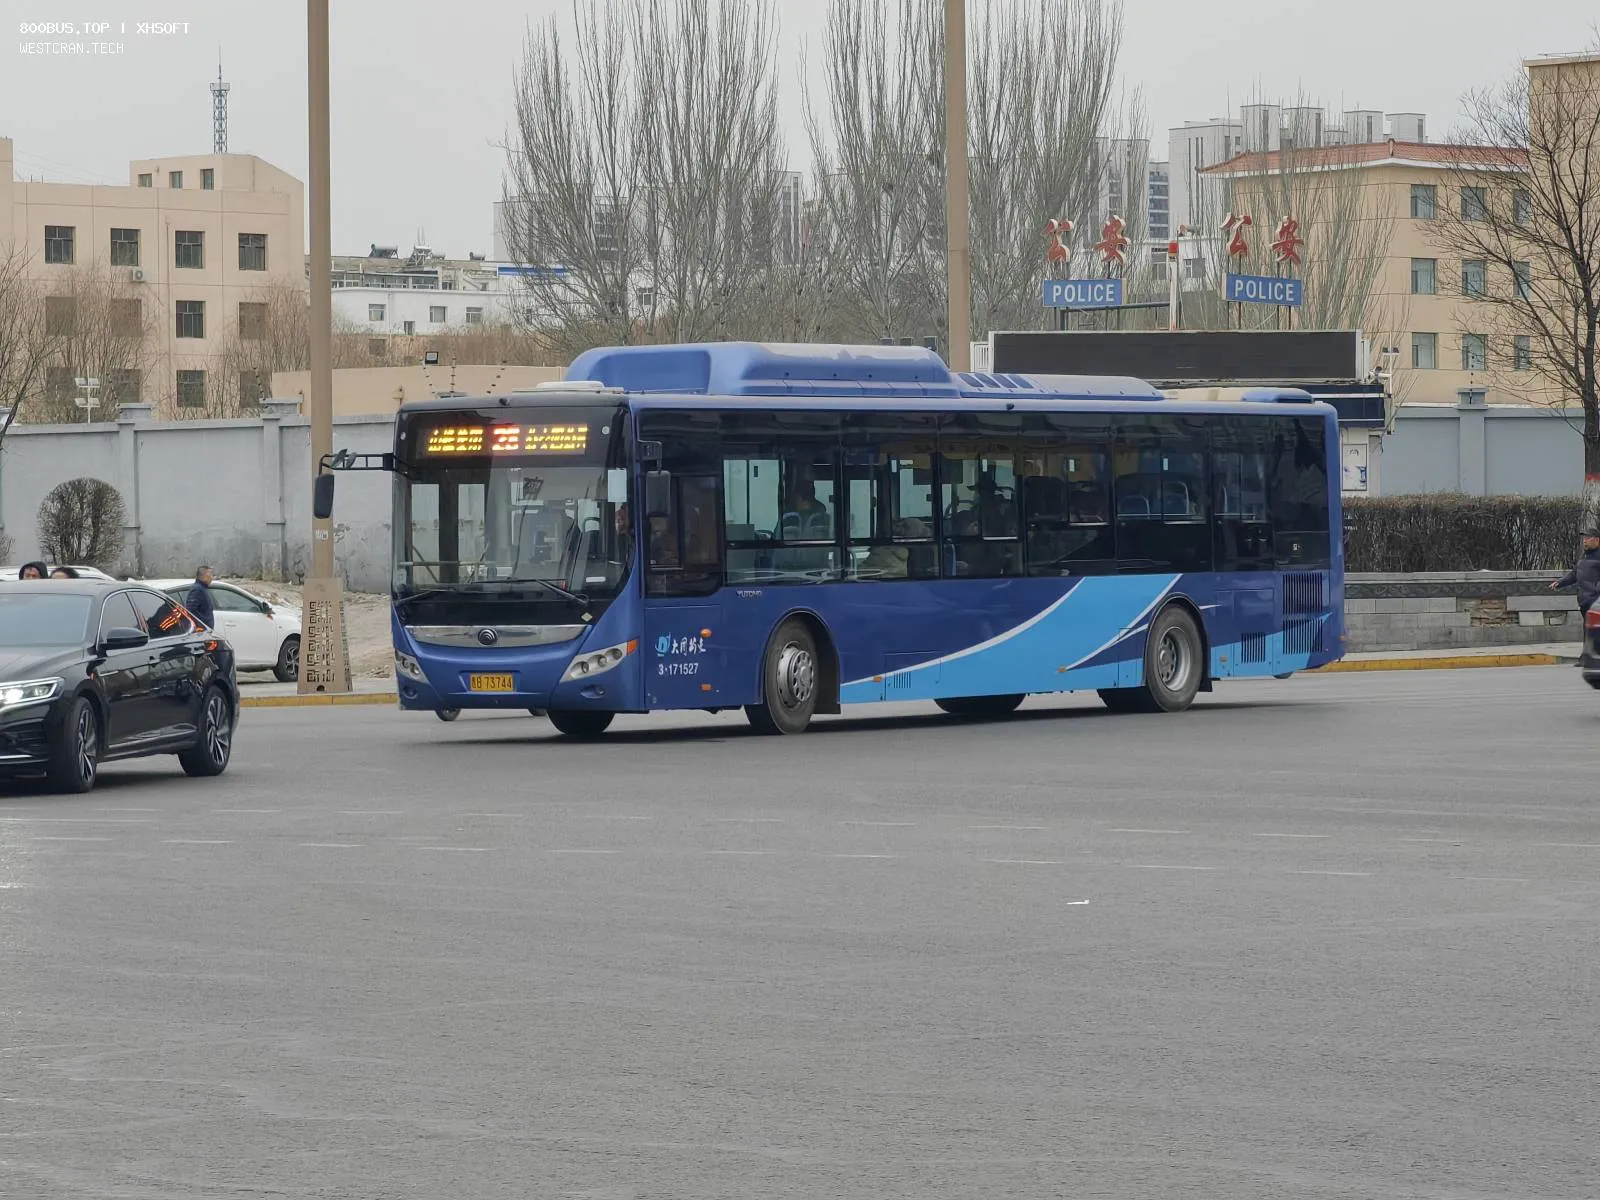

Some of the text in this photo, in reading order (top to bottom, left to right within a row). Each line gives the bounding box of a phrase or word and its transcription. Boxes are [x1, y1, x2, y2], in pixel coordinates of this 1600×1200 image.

[1041, 214, 1131, 265] 公安
[1220, 212, 1304, 265] 公安
[1053, 284, 1115, 303] POLICE
[1235, 279, 1295, 301] POLICE
